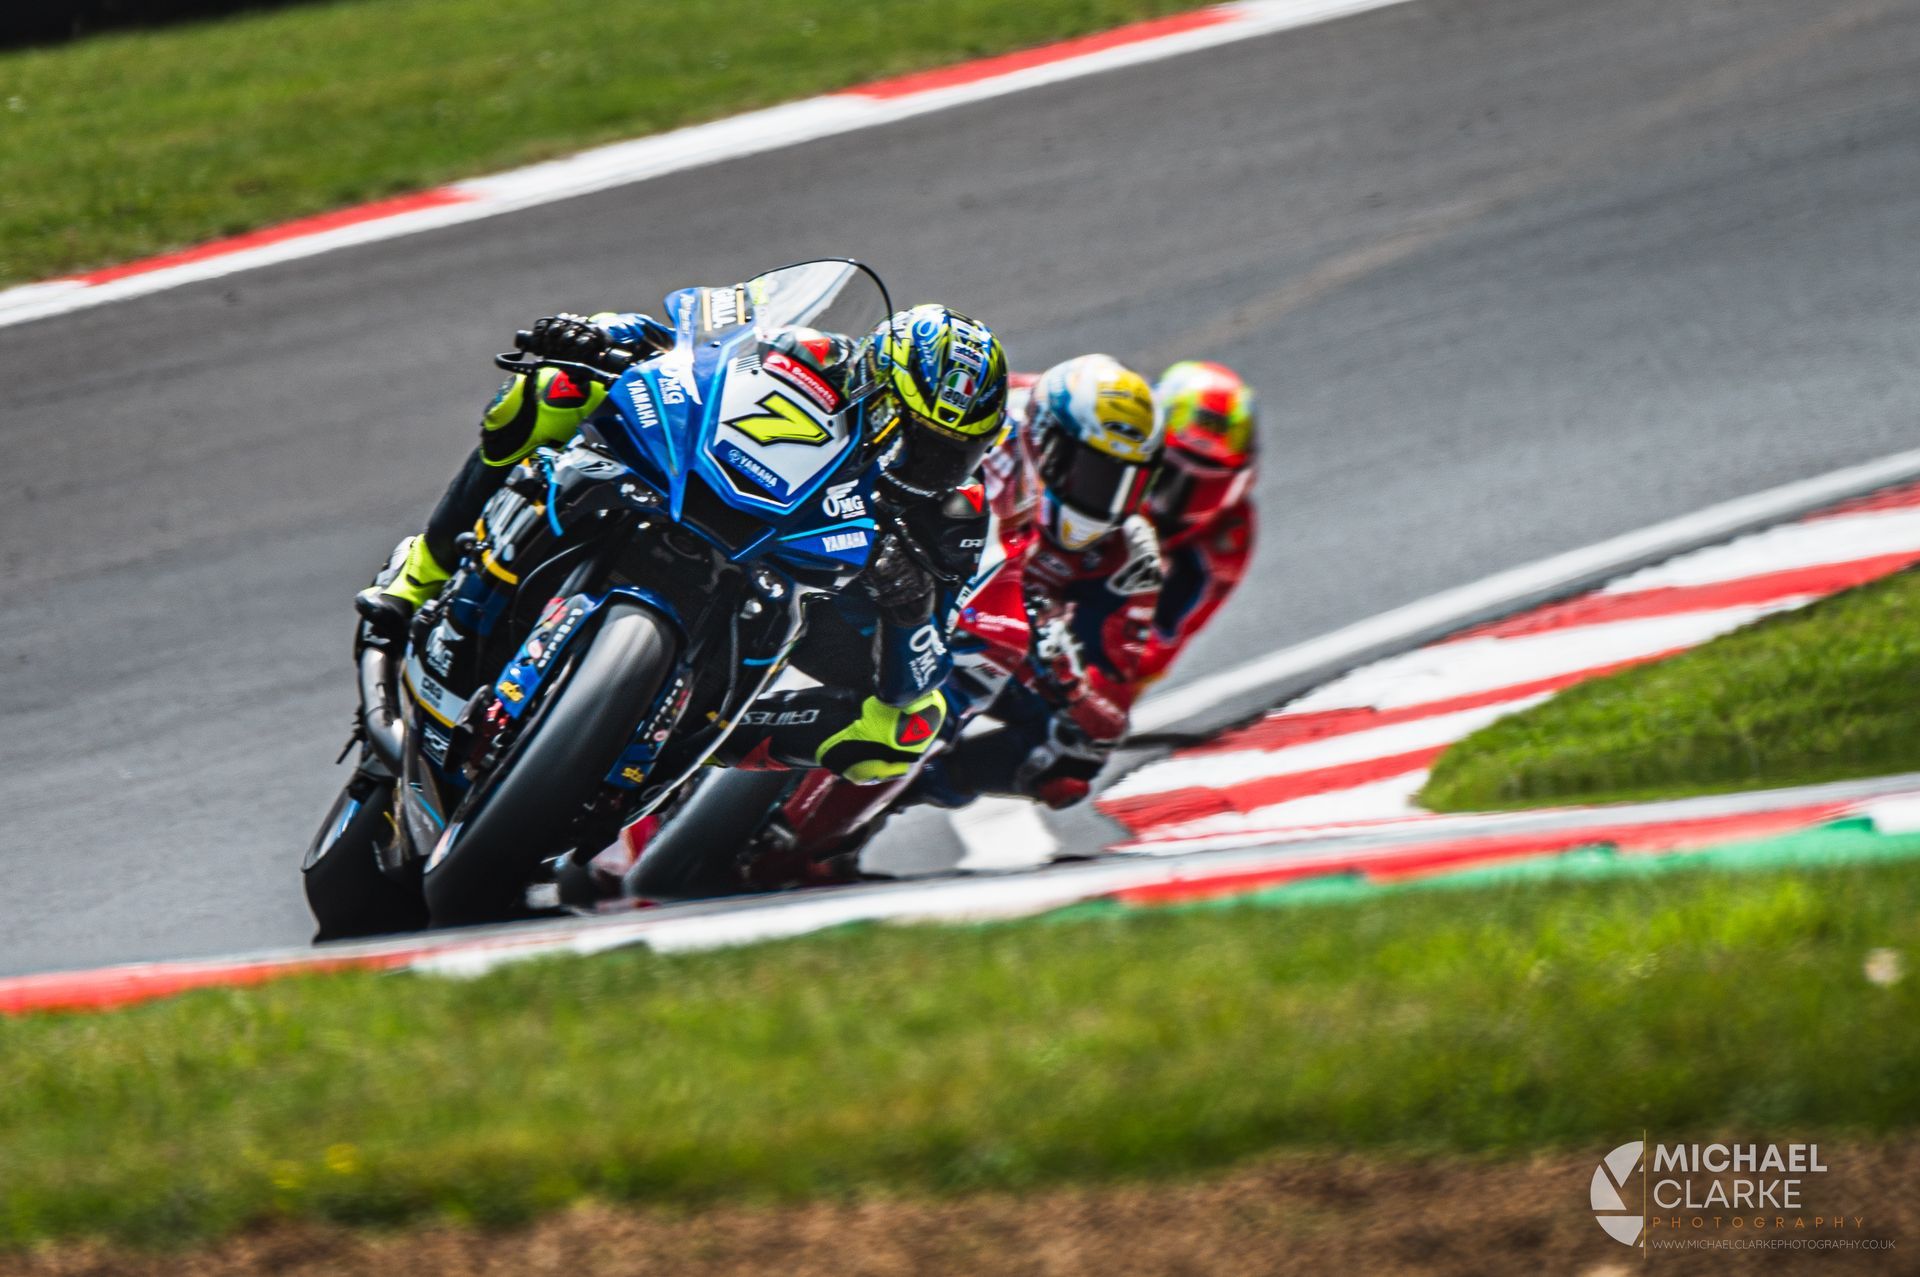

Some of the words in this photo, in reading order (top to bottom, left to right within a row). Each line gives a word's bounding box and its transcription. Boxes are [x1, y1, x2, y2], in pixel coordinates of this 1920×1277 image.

[626, 379, 659, 429] YAMAHA
[721, 390, 833, 447] 7
[740, 454, 779, 487] YAMAHA
[822, 495, 866, 517] OMG
